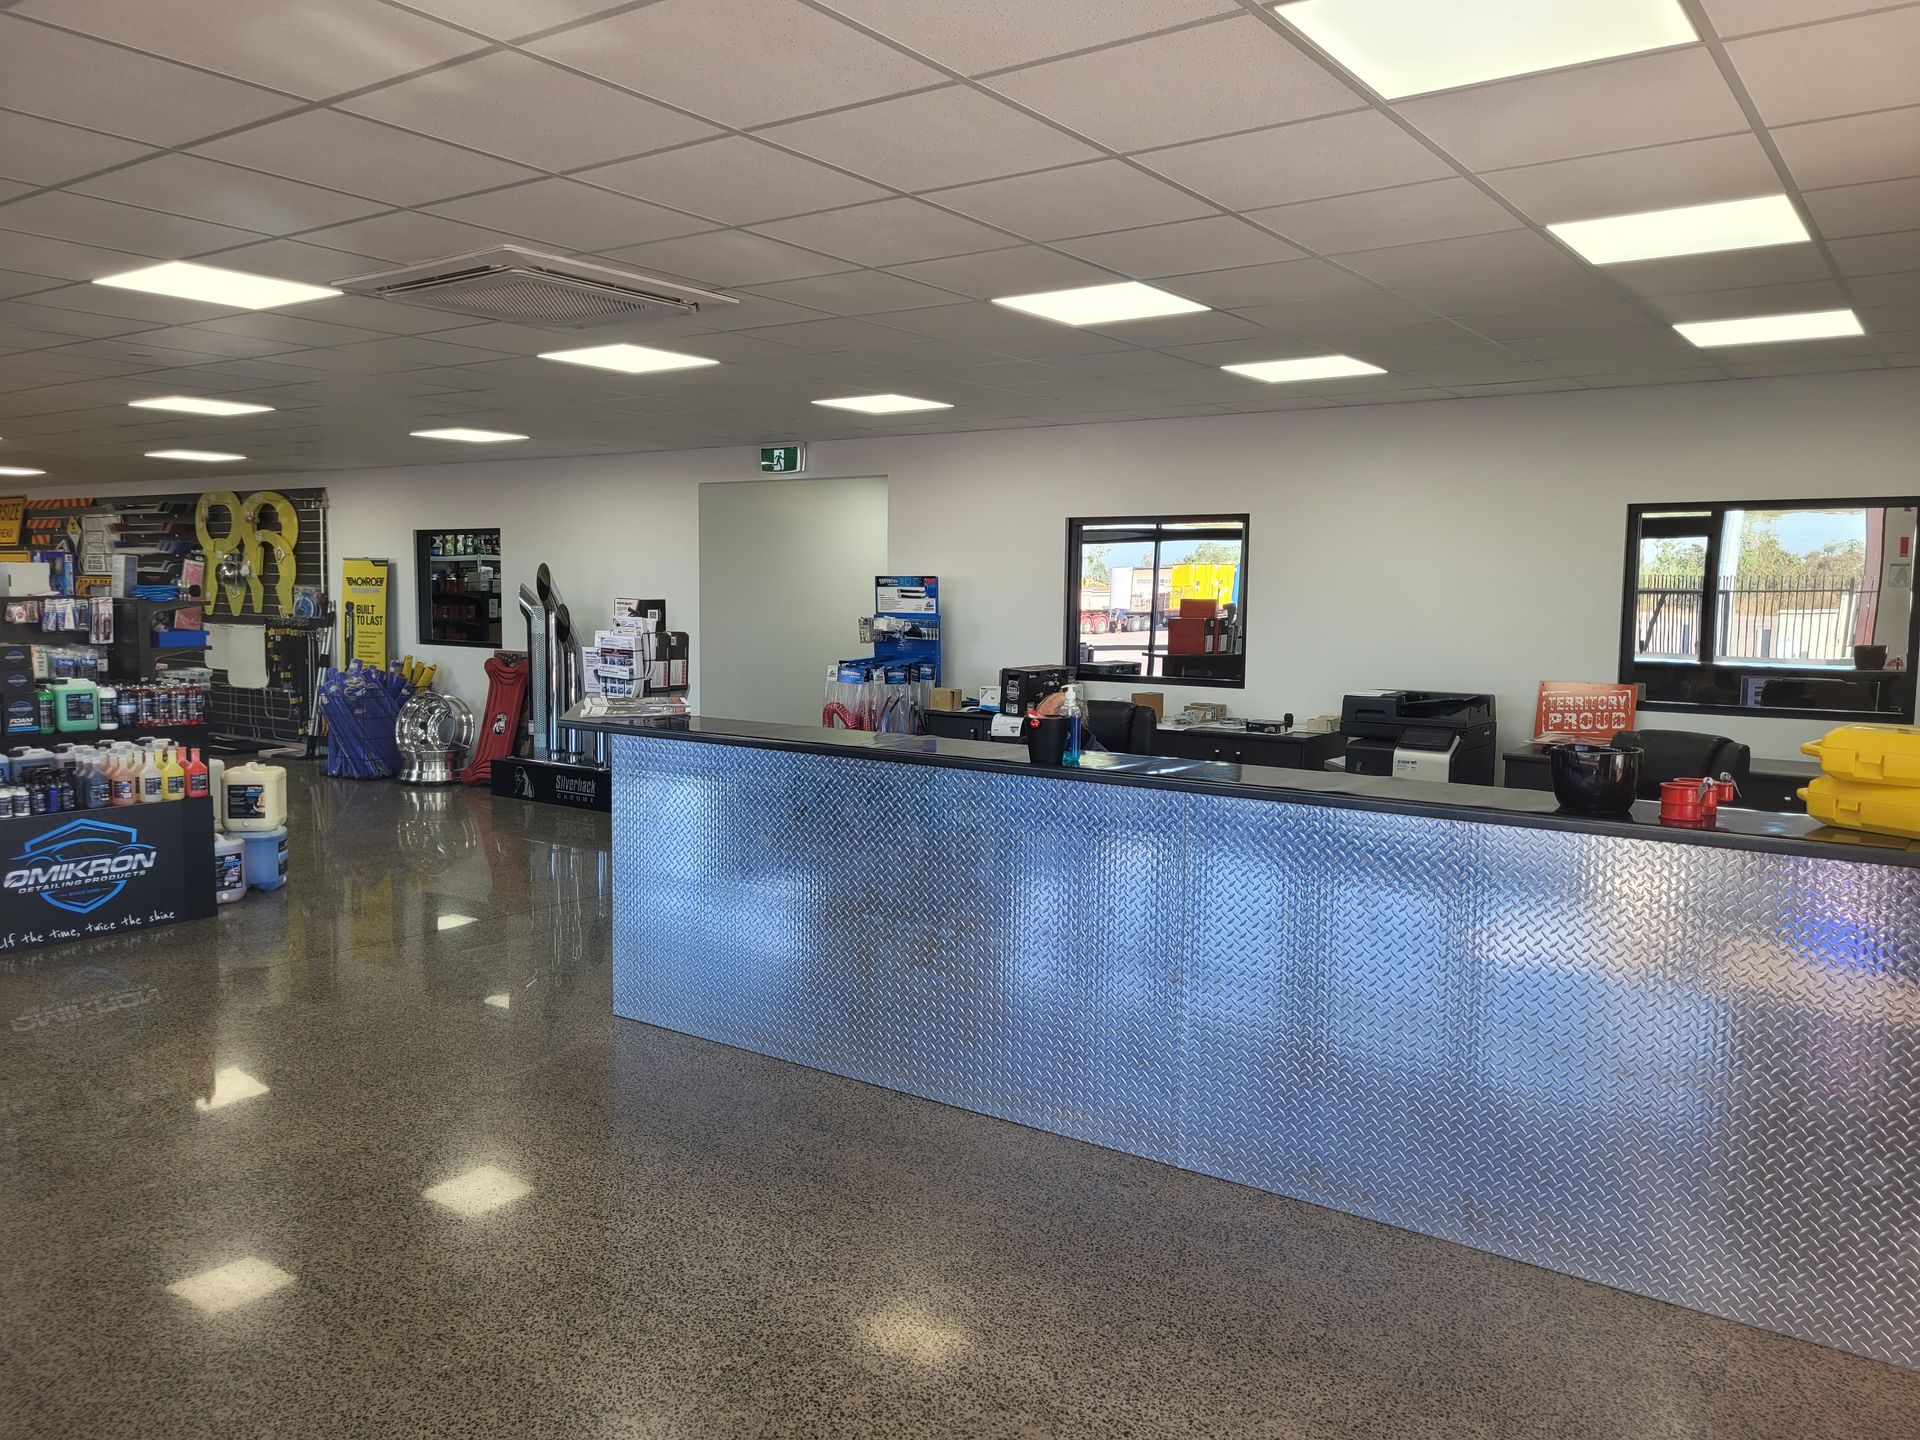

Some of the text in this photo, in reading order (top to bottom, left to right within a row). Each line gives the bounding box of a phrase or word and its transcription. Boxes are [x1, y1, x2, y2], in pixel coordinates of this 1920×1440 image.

[348, 577, 384, 586] MONROE
[357, 605, 375, 614] BUILT
[357, 615, 383, 625] TO LAST
[1548, 695, 1627, 711] TERRITORY
[1548, 712, 1626, 730] PROUD
[555, 775, 596, 794] Silverback
[556, 792, 594, 803] CHROME
[3, 851, 158, 889] OMIKRON
[18, 880, 83, 895] DETAILING
[84, 869, 148, 885] PRODUCTS
[21, 930, 44, 944] the
[85, 921, 117, 933] twice
[121, 914, 142, 926] the
[149, 910, 176, 923] shine
